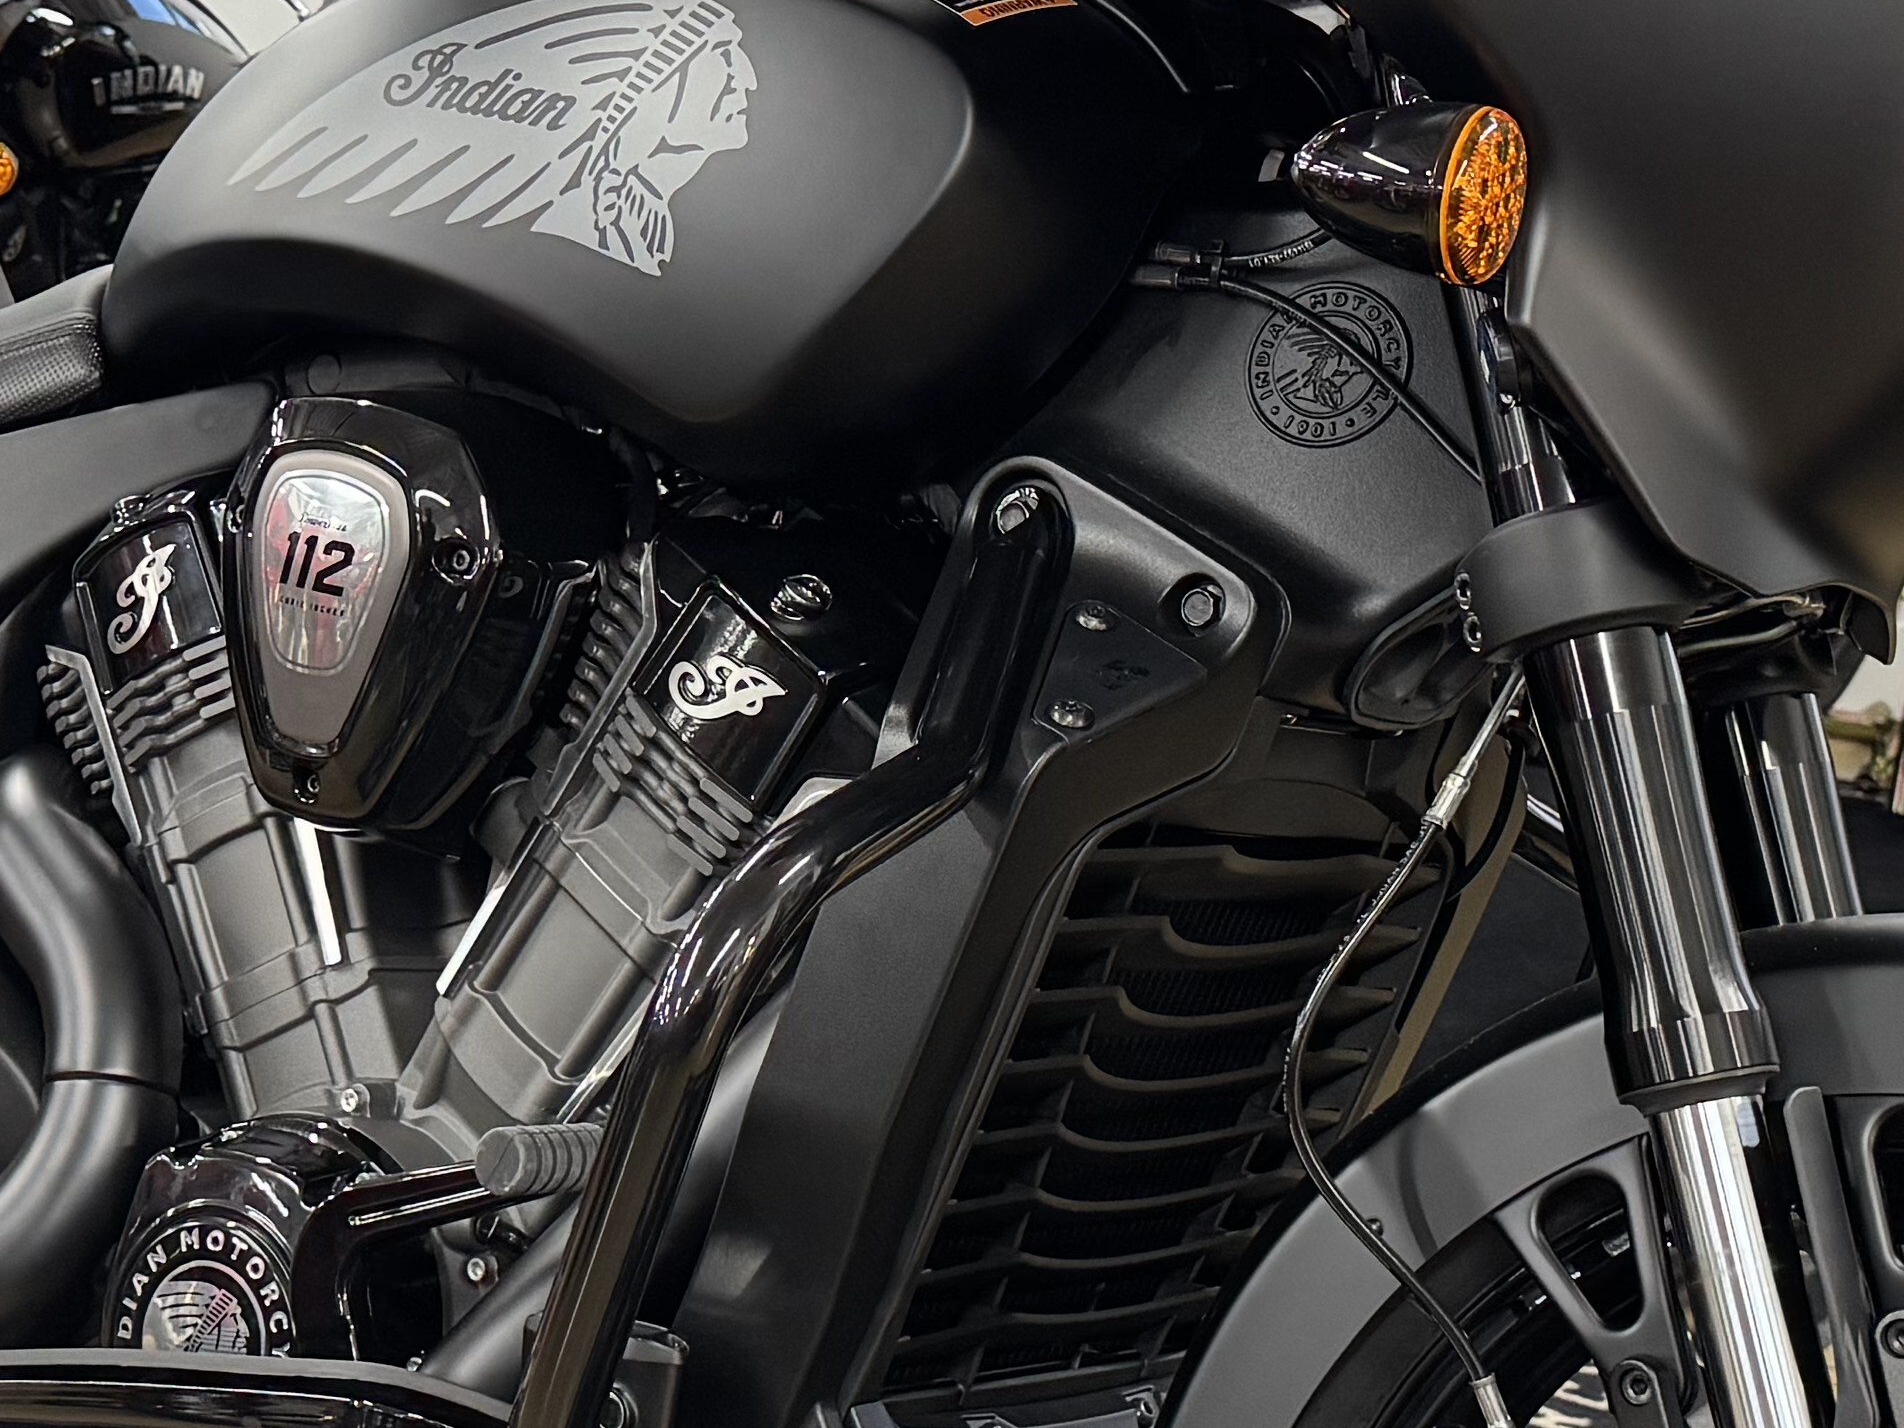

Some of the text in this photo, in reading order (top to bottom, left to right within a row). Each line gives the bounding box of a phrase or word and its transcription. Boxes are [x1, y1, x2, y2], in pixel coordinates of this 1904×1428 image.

[91, 64, 205, 107] INDIAN
[384, 42, 577, 131] Indian
[1309, 291, 1402, 419] MOTORCYLE
[1283, 415, 1337, 438] 1901
[279, 530, 356, 598] 112
[117, 1243, 168, 1340] DIAN
